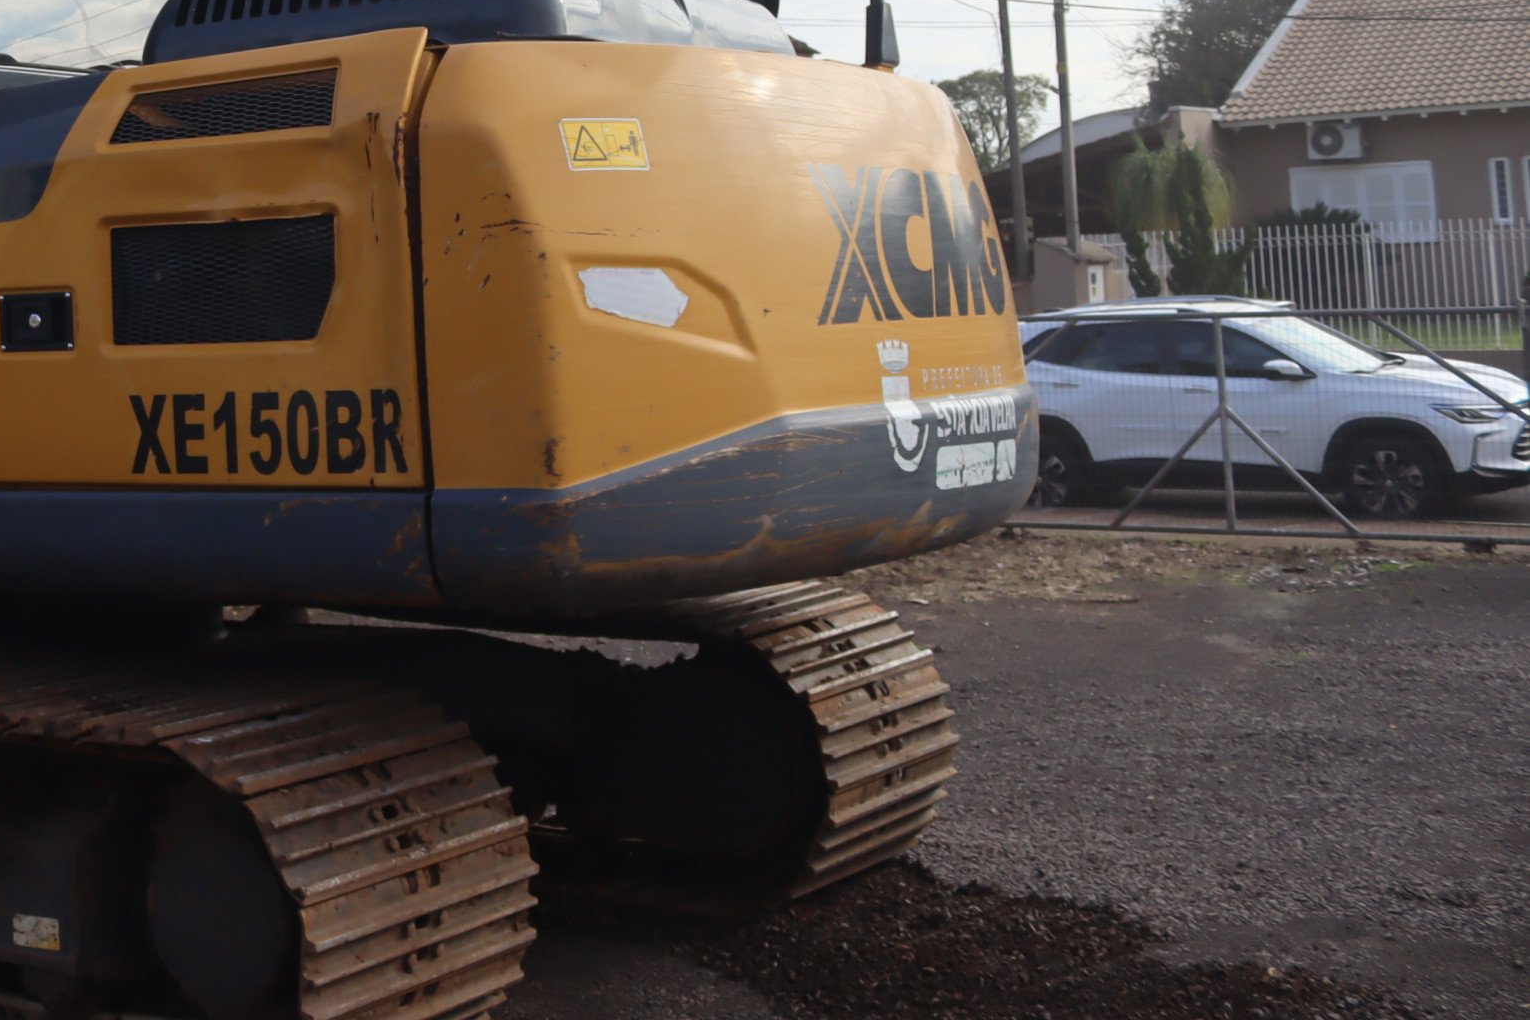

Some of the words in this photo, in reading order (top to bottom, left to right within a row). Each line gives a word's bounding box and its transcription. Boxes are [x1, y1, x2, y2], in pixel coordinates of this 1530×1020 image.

[807, 163, 1006, 326] XCMG
[921, 365, 990, 390] PREFEIRA
[129, 388, 408, 476] XE150BR
